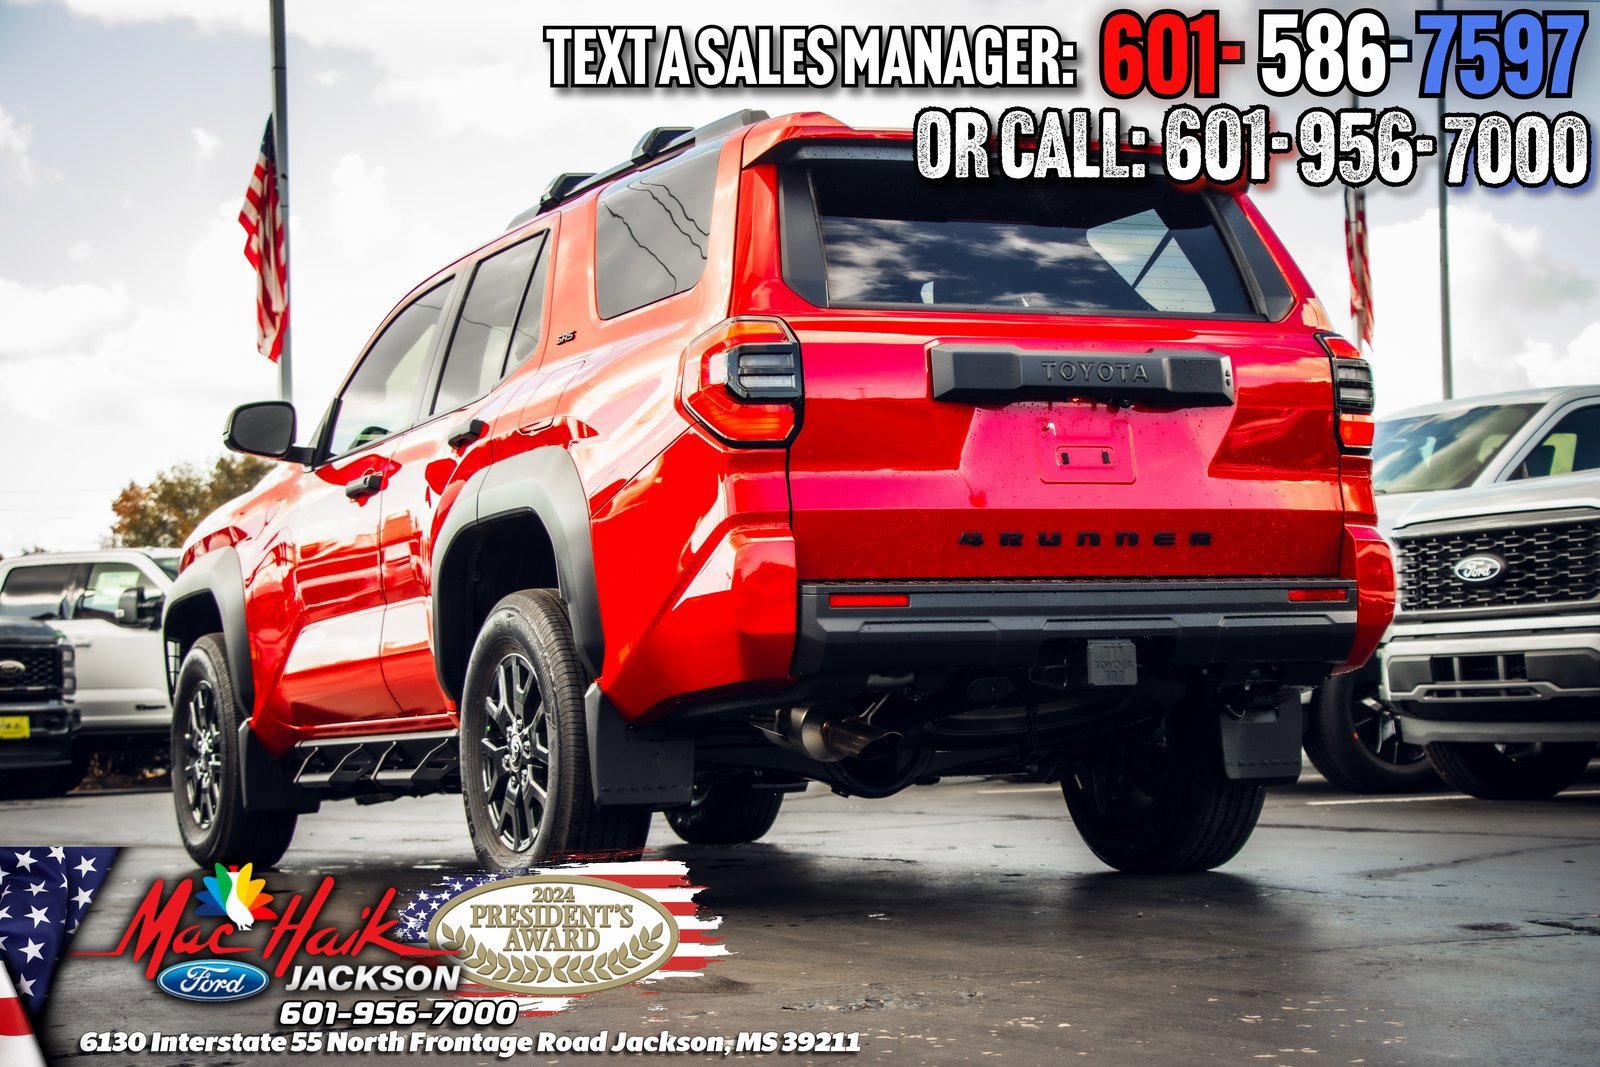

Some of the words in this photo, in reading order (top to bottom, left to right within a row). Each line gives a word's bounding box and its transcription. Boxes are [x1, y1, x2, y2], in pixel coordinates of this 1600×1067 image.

[1041, 361, 1150, 383] TOYOTA
[958, 532, 1213, 547] 4RUNNER
[1462, 560, 1492, 578] Ford
